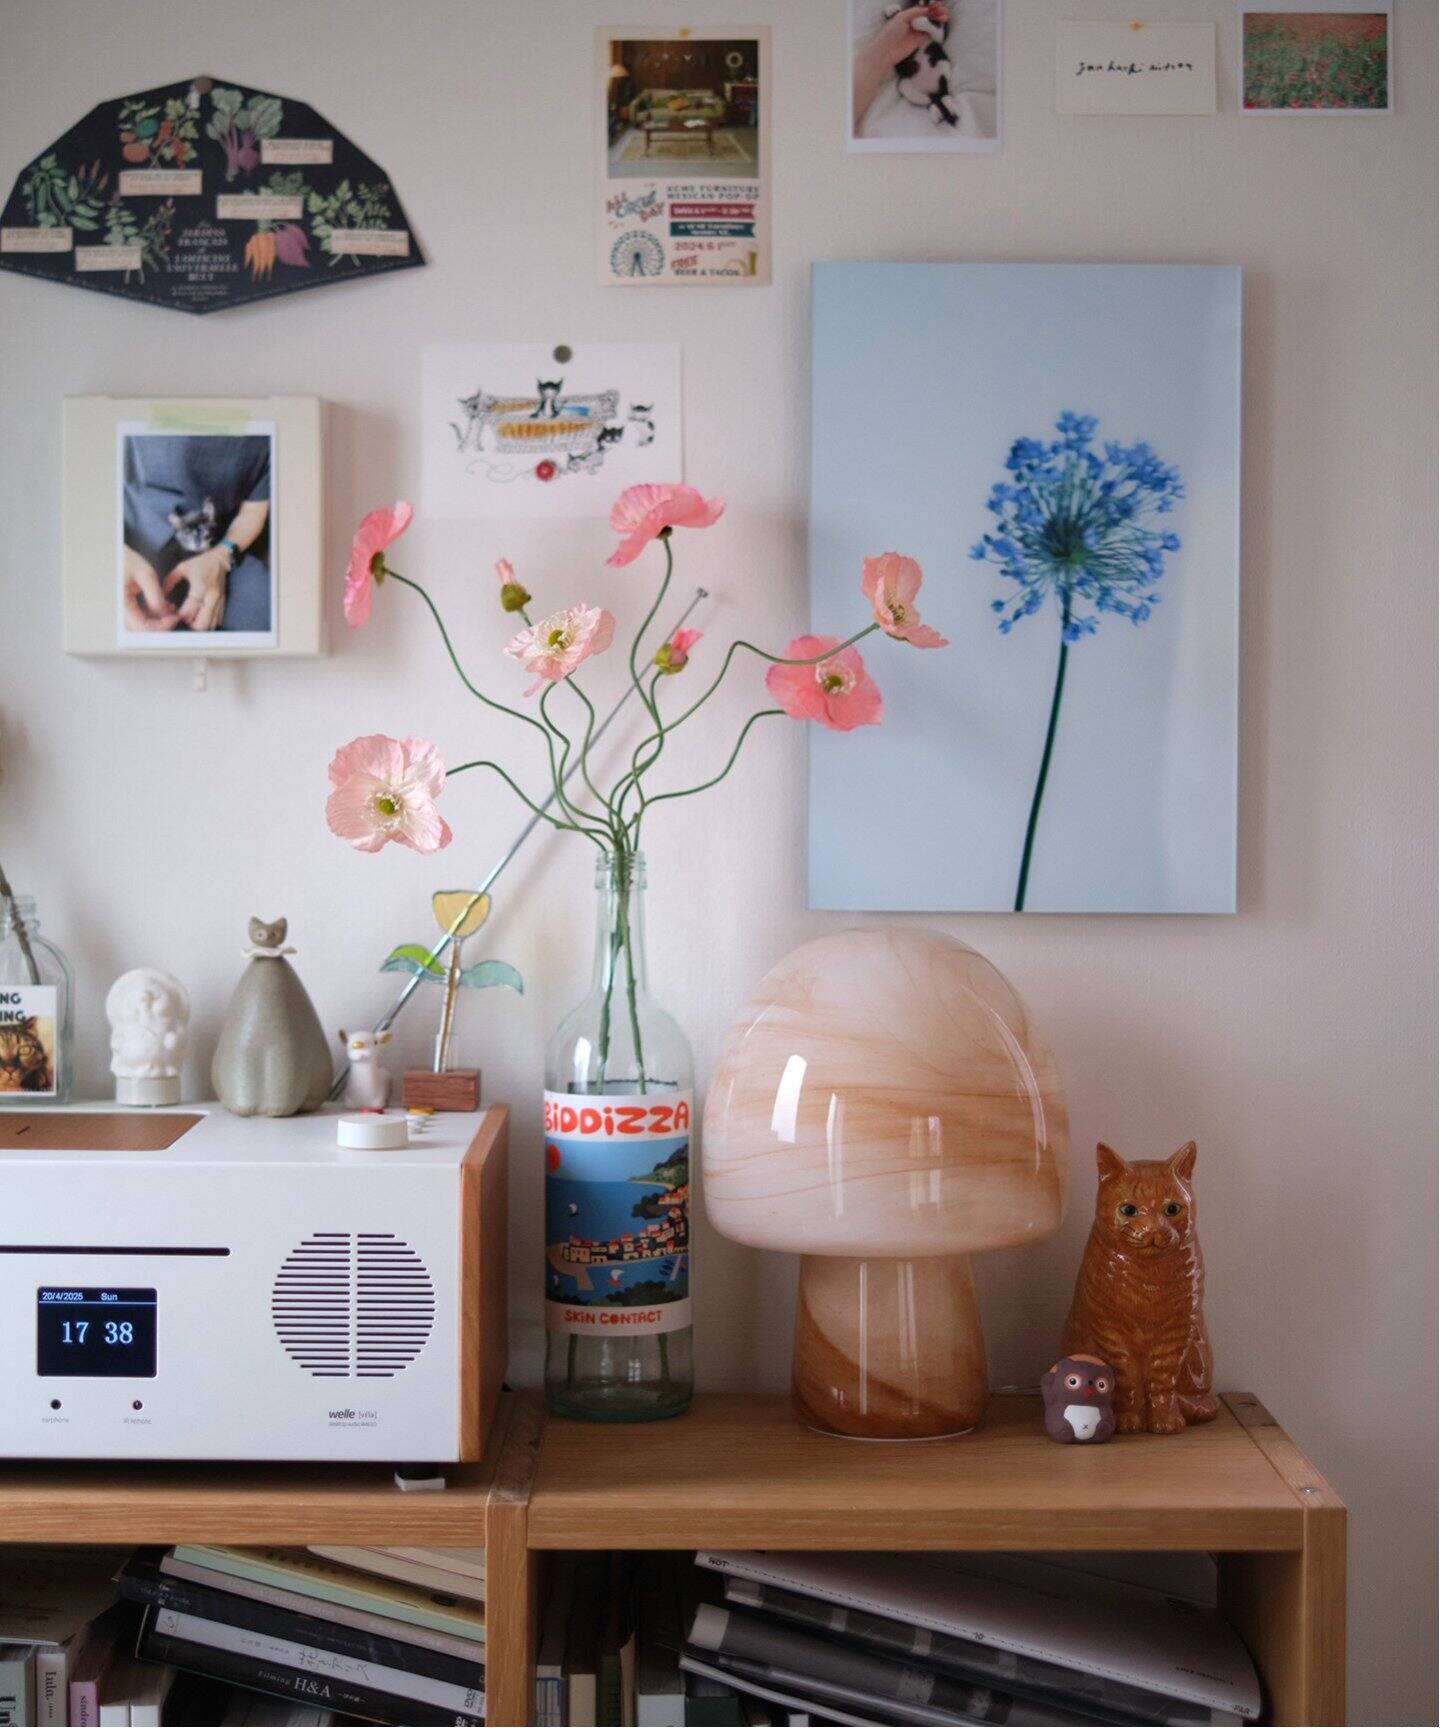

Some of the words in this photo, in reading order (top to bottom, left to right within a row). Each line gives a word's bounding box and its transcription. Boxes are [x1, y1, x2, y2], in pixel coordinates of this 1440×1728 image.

[42, 1292, 84, 1301] 20/4/2025
[100, 1293, 118, 1301] Sun
[599, 1310, 662, 1325] CONTACT
[62, 1321, 89, 1344] 17
[104, 1321, 133, 1344] 38
[328, 1408, 356, 1419] welle
[293, 1677, 332, 1698] H&A
